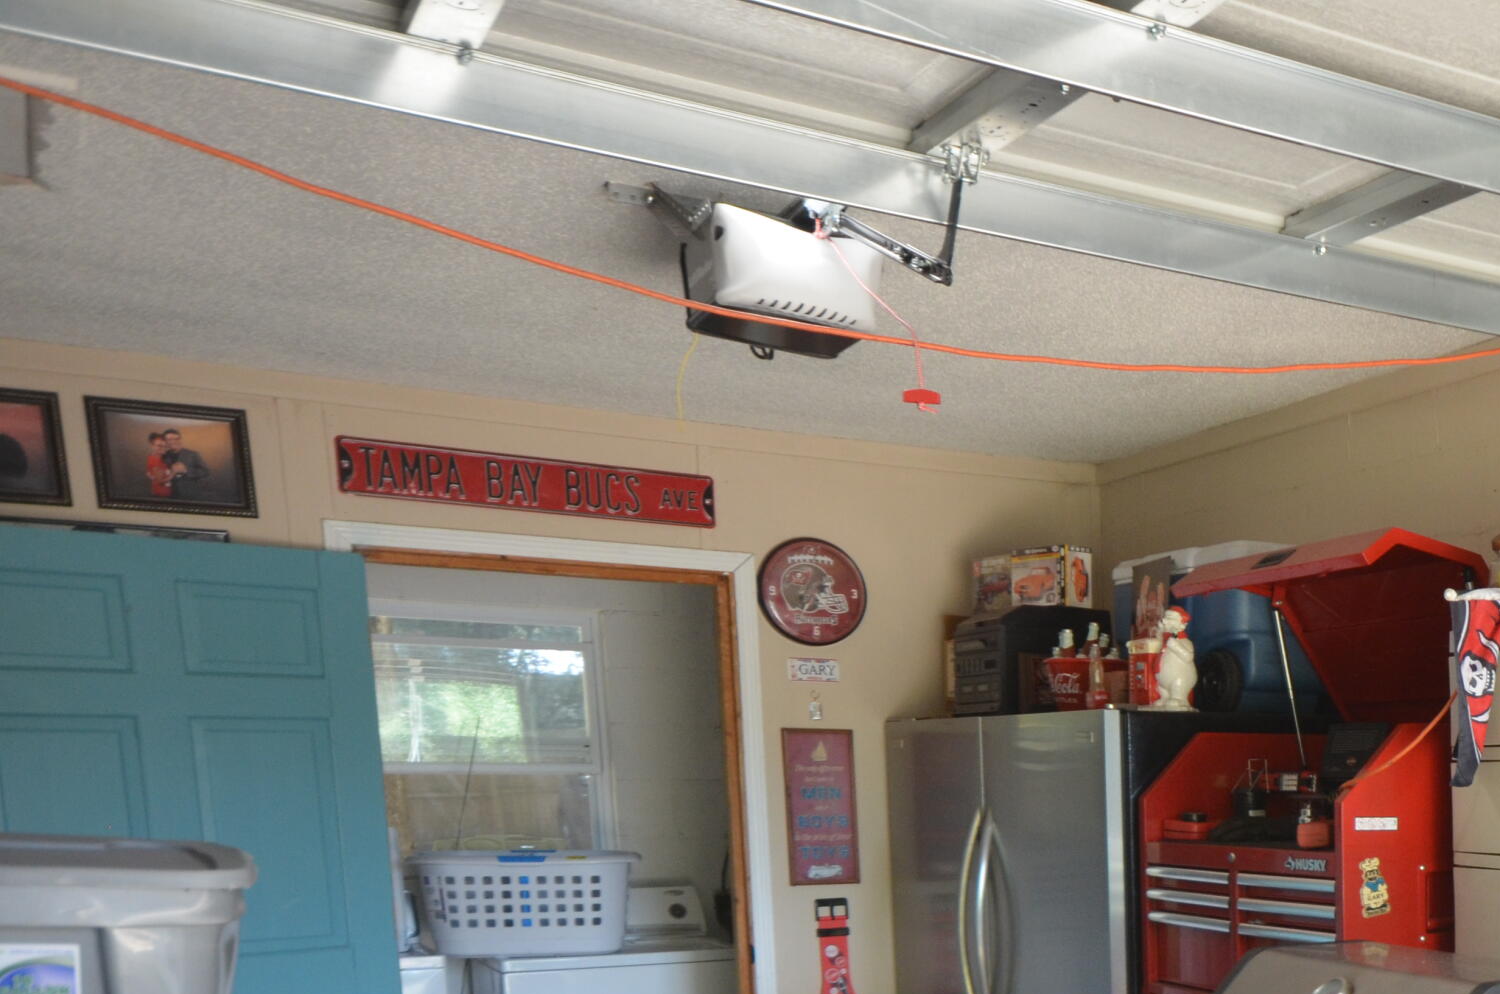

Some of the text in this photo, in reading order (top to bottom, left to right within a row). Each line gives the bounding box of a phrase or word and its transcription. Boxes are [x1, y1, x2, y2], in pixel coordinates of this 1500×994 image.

[358, 446, 700, 515] TAMPA BAY BUCS AVE
[798, 663, 836, 677] GARY
[1295, 858, 1327, 872] HUSKY
